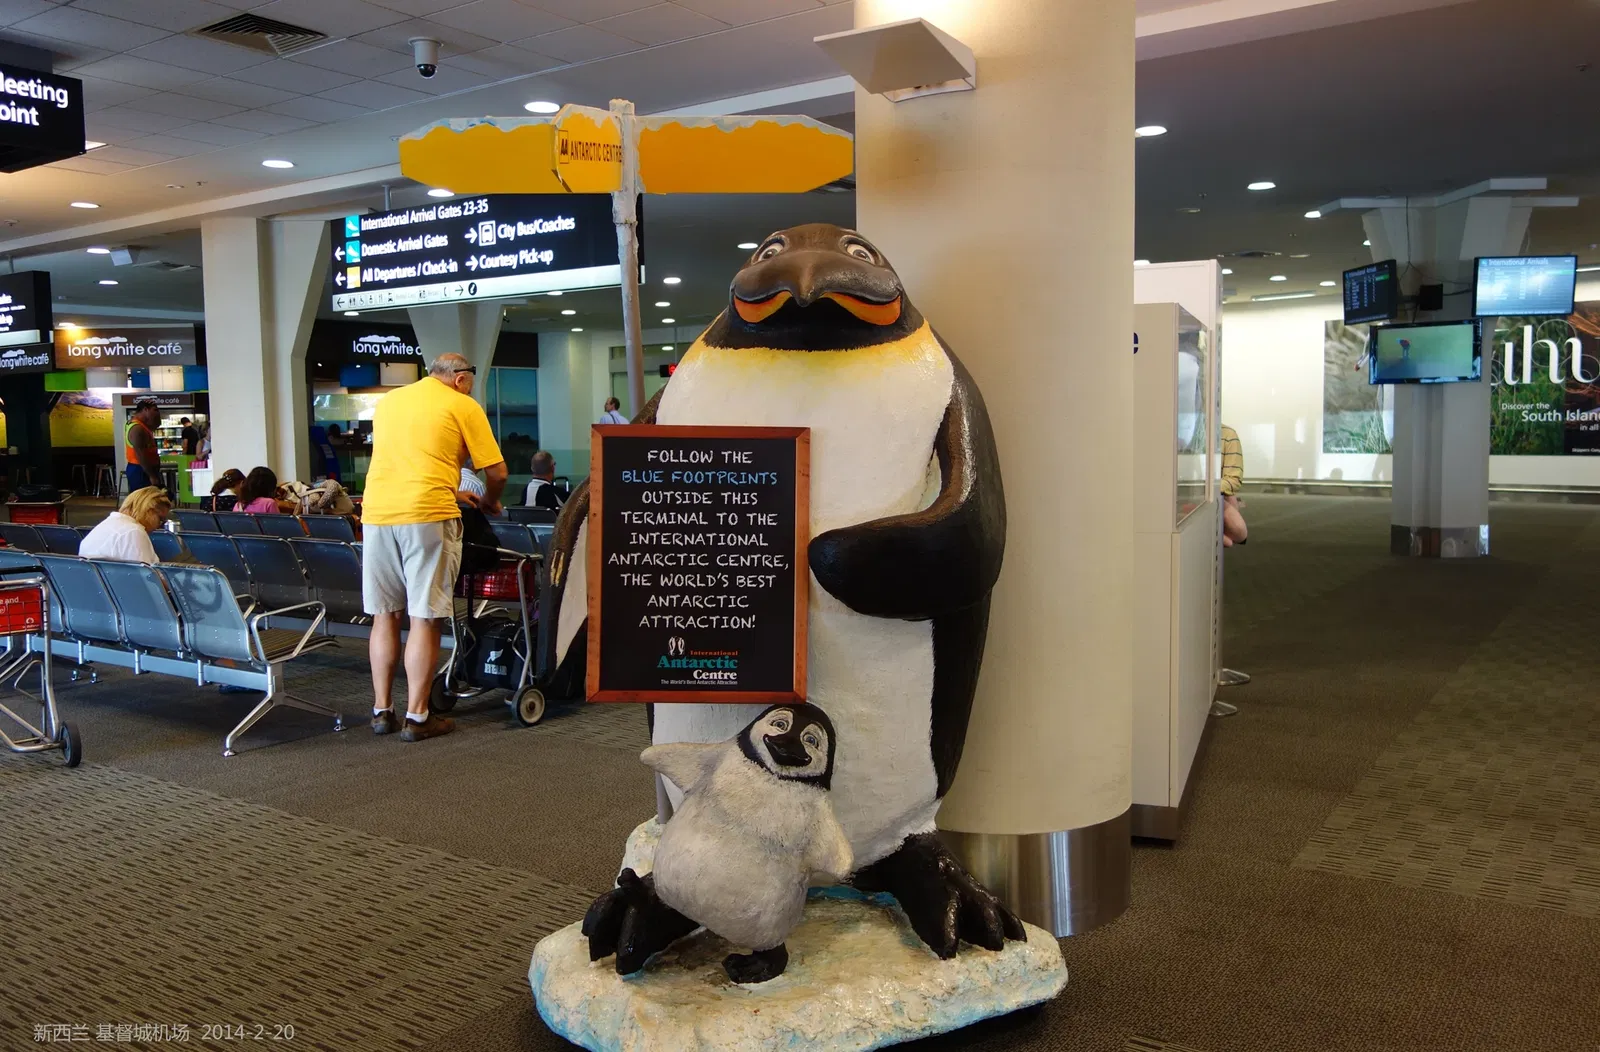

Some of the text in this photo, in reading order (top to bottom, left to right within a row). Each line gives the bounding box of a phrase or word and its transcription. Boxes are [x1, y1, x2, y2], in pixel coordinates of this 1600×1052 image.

[570, 141, 601, 161] ANTARCTIC
[361, 199, 489, 230] International Arrival Gates 23-35
[497, 215, 576, 241] City Bus/Coaches
[361, 234, 449, 257] Domestic Arrival Gates
[479, 248, 554, 269] Courtesy Pick-up
[362, 267, 373, 282] All
[374, 264, 416, 283] Departures
[422, 258, 458, 275] Check-in
[68, 342, 183, 359] long white café
[353, 341, 380, 357] long
[381, 342, 414, 355] white
[14, 355, 32, 367] white
[32, 352, 49, 365] café
[1536, 402, 1550, 410] the
[1521, 410, 1562, 422] South
[1589, 423, 1599, 431] all
[647, 450, 753, 464] FOLLOW THE
[622, 470, 778, 485] BLUE FOOTPRINTS
[642, 491, 759, 505] OUTSIDE THIS
[621, 511, 778, 526] TERMINAL TO THE
[629, 532, 769, 546] INTERNATIONAL
[608, 553, 789, 570] ANTARCTIC CENTRE,
[621, 573, 777, 588] THE WORLD'S BEST
[647, 594, 750, 608] ANTARCTIC
[639, 615, 756, 629] ATTRACTION!
[657, 655, 739, 669] Antarctic
[692, 669, 738, 680] Centre
